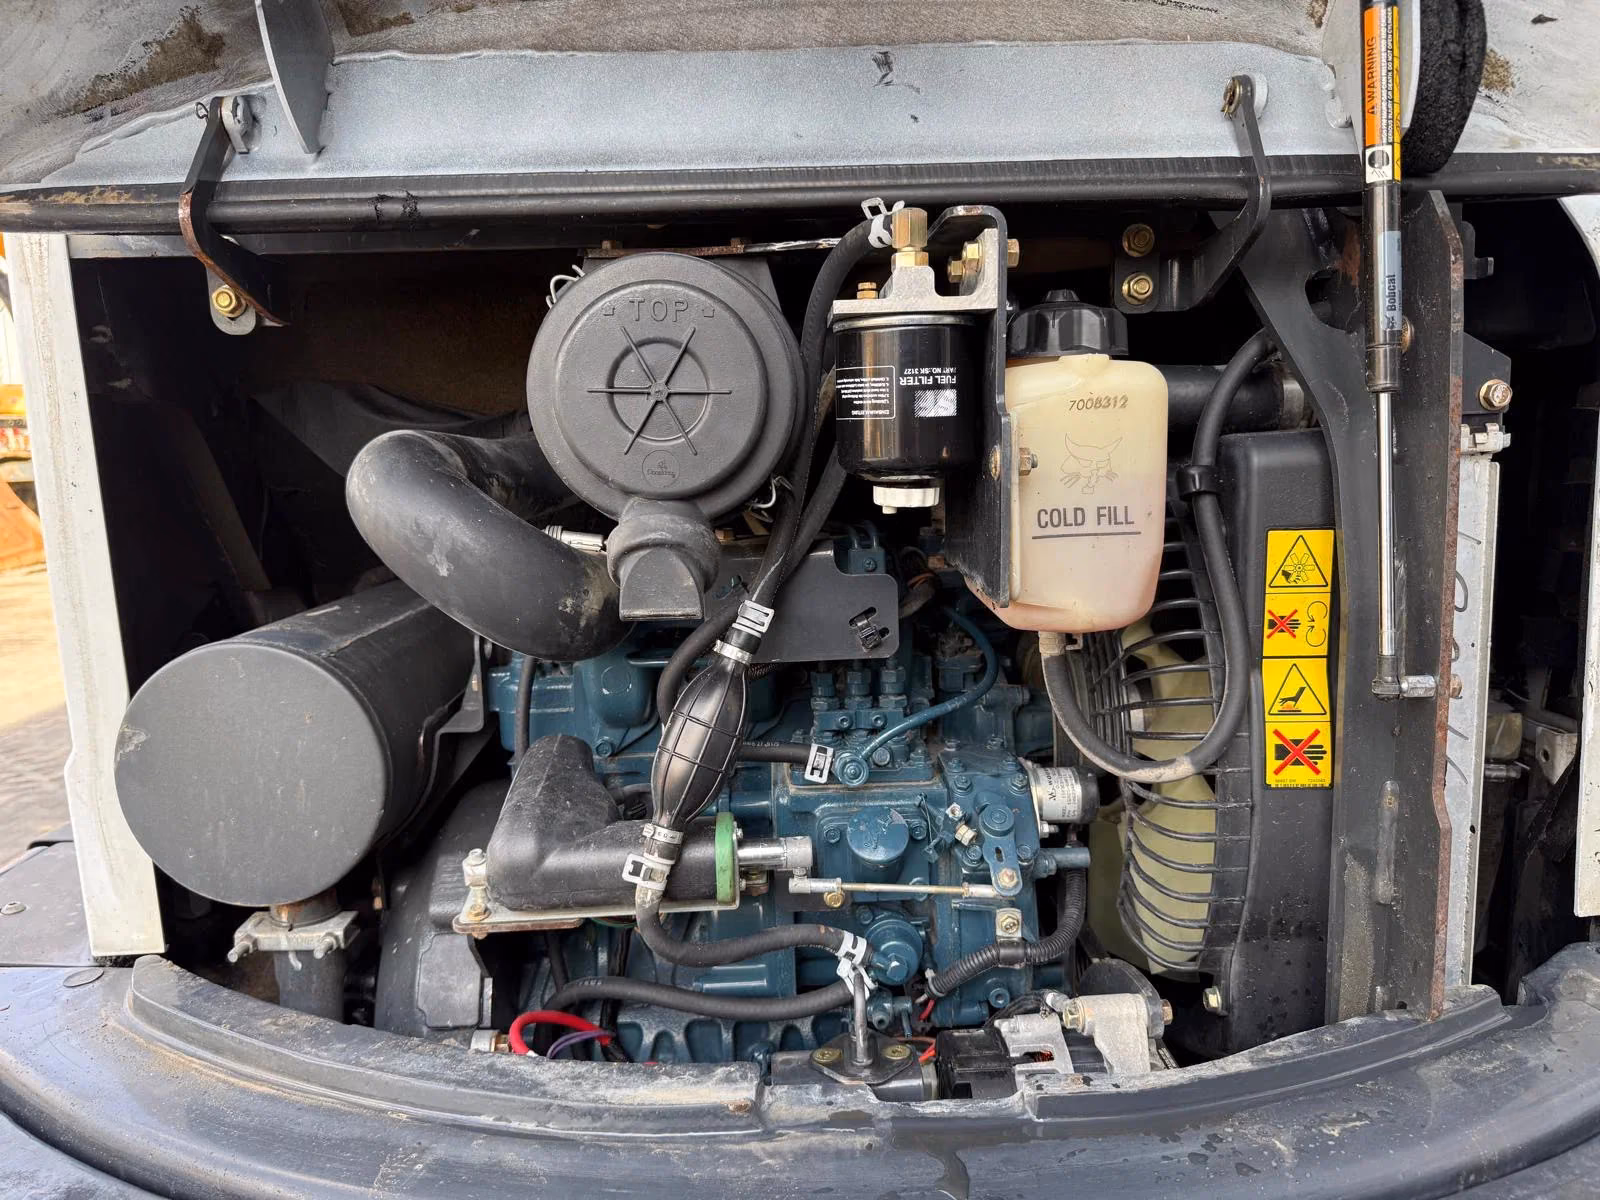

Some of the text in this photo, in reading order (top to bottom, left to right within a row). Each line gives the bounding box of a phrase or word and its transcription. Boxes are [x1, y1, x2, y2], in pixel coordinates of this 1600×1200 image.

[1367, 37, 1377, 103] WARNING
[1386, 274, 1397, 311] Bobcat
[629, 298, 689, 322] TOP
[899, 375, 957, 385] FUEL FILTER
[1068, 395, 1129, 411] 7008312
[1037, 506, 1134, 528] COLD FILL
